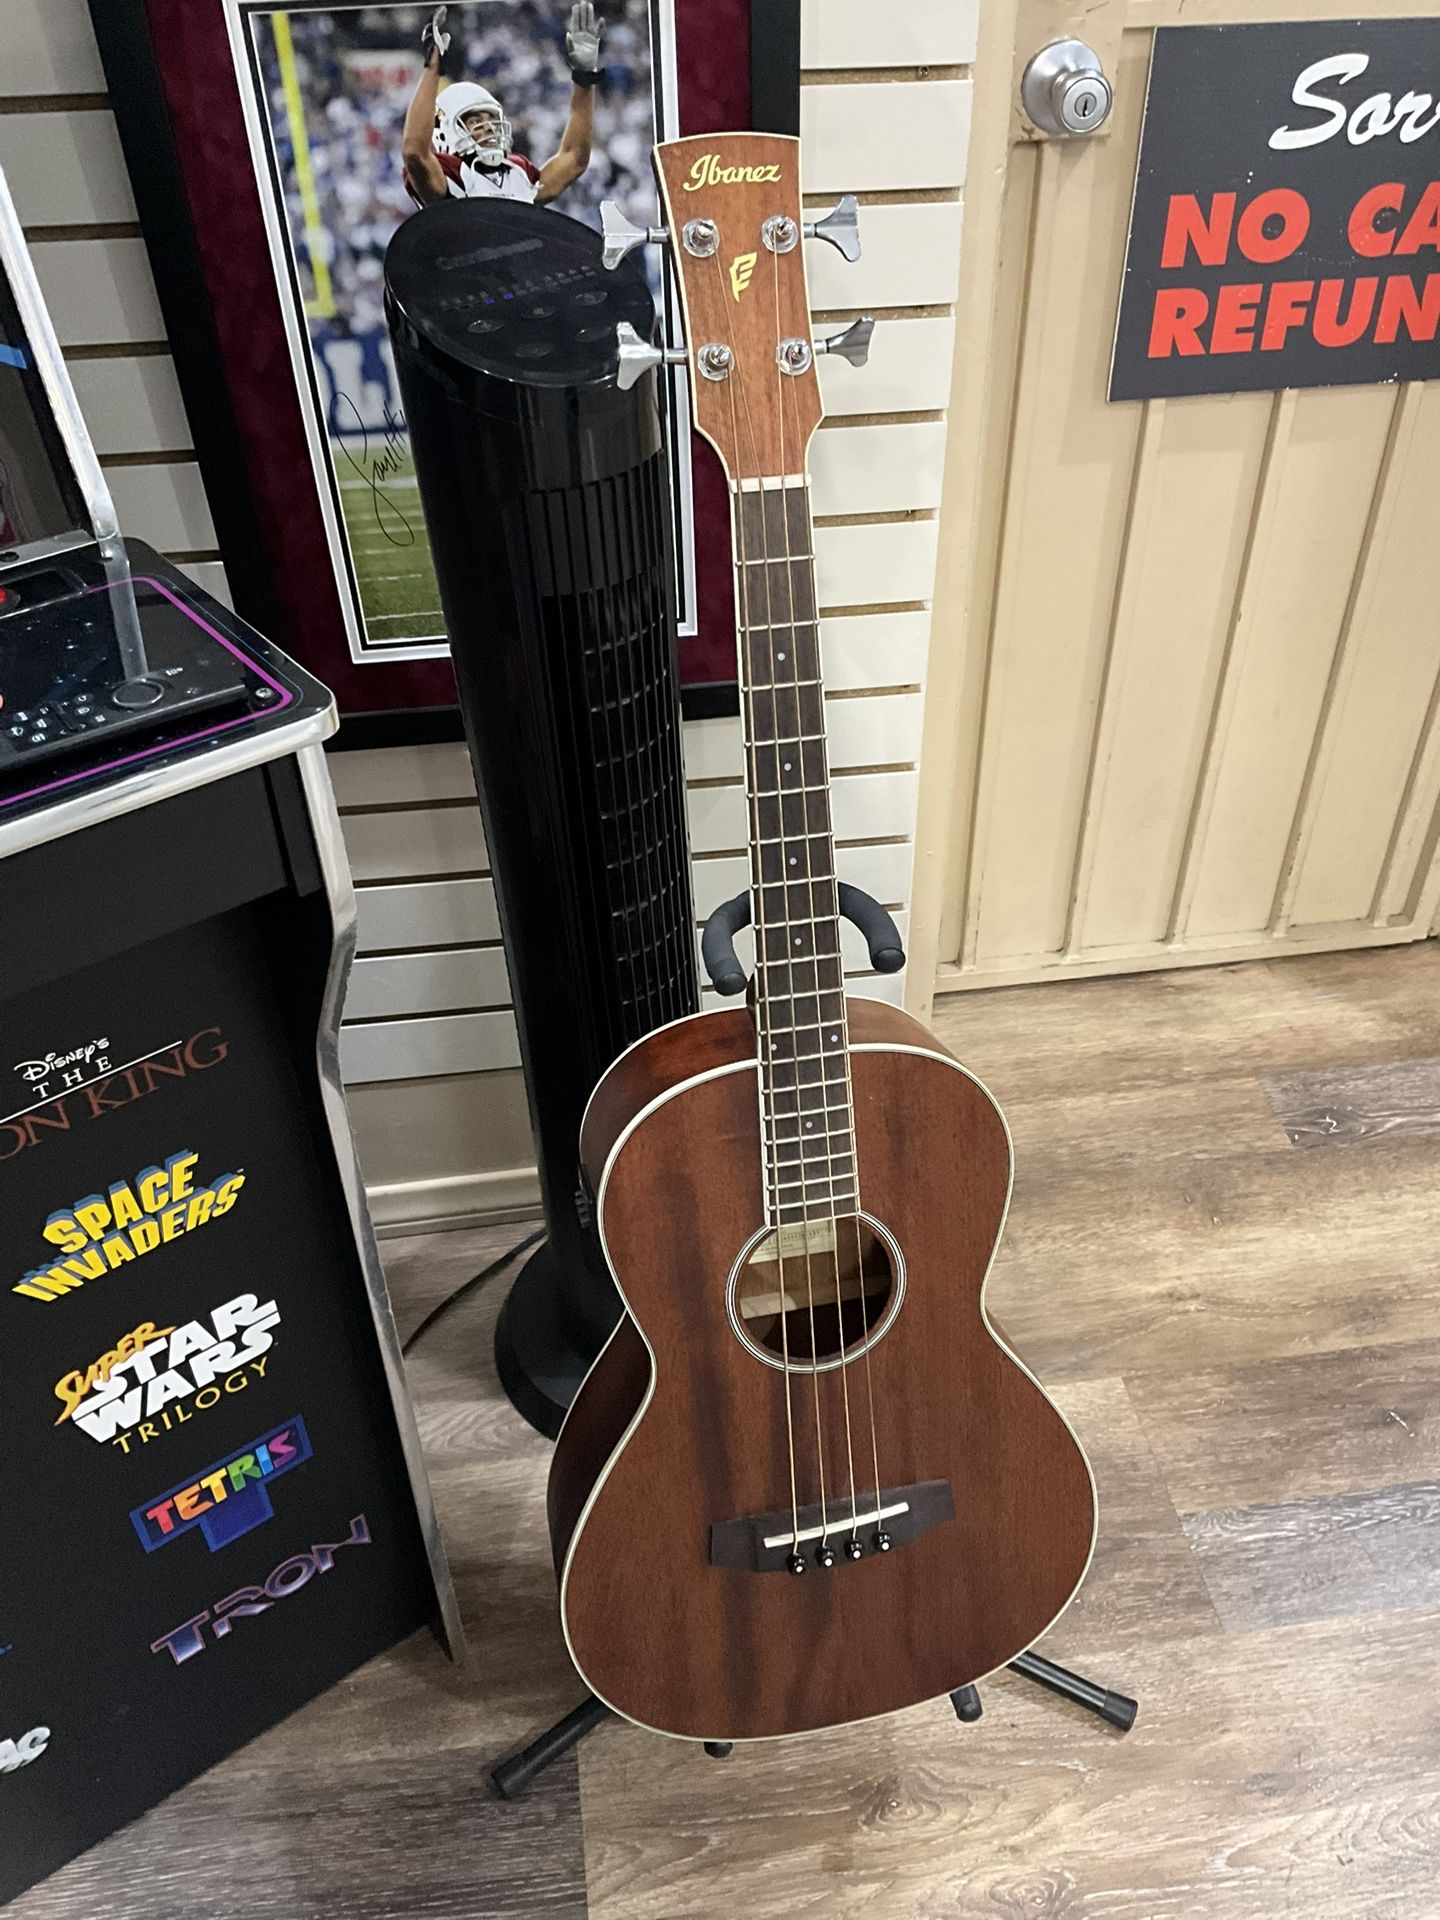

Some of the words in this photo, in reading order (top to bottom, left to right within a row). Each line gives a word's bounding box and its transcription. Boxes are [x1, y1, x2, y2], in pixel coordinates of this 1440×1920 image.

[1267, 53, 1440, 150] Sor
[682, 154, 782, 192] Ibanez
[1160, 187, 1311, 268] NO
[1147, 273, 1440, 358] REFUN
[32, 1056, 112, 1098] THE
[82, 1026, 229, 1119] KING
[11, 1173, 246, 1302] INVADERS
[43, 1149, 199, 1253] SPACE
[71, 1293, 278, 1421] STAR
[75, 1310, 282, 1443] WARS
[112, 1356, 268, 1454] TRILOGY
[146, 1430, 297, 1534] TETRIS
[150, 1513, 372, 1665] TRON
